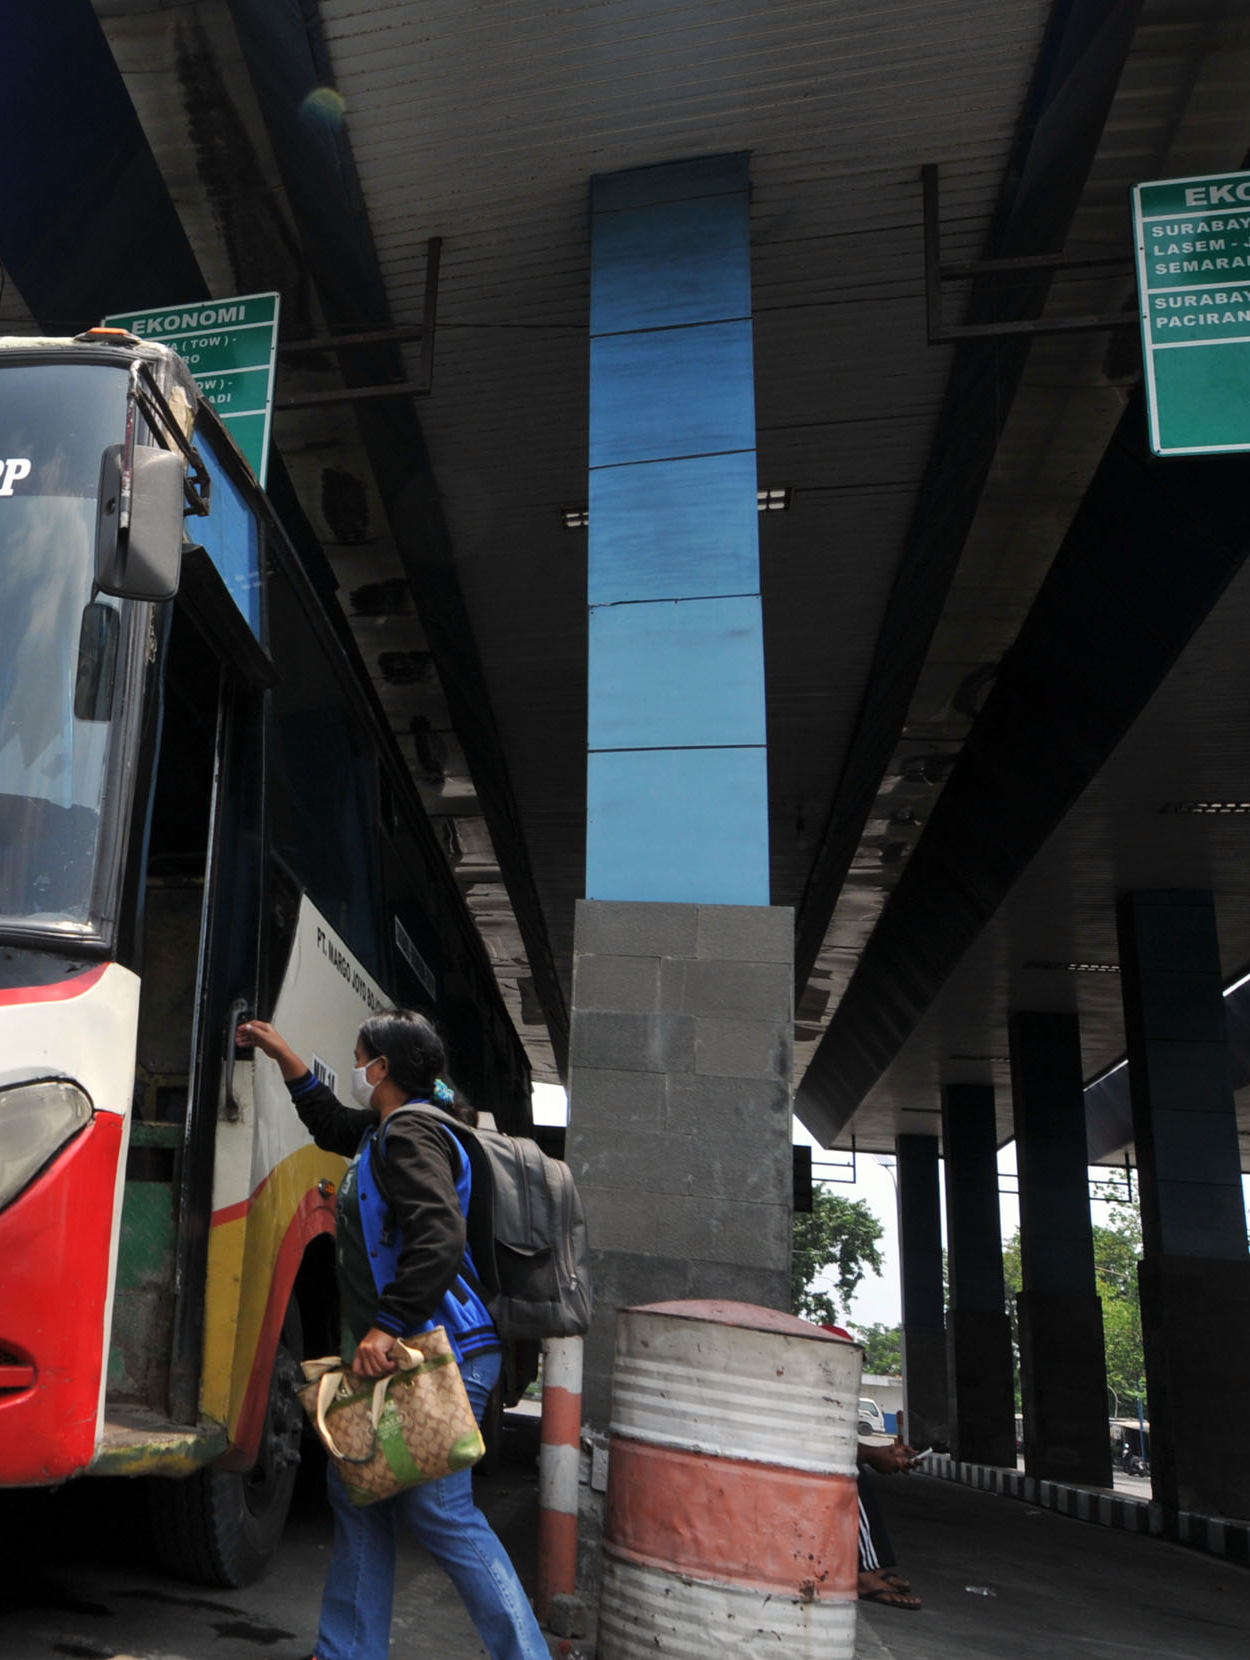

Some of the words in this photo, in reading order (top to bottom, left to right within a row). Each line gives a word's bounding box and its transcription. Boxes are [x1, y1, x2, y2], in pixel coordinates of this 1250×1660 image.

[1154, 239, 1225, 256] LASEM
[1155, 256, 1250, 275] SEMARA
[131, 305, 246, 336] EKONOMI
[1156, 310, 1250, 328] PACIRAN
[190, 336, 221, 349] TOW
